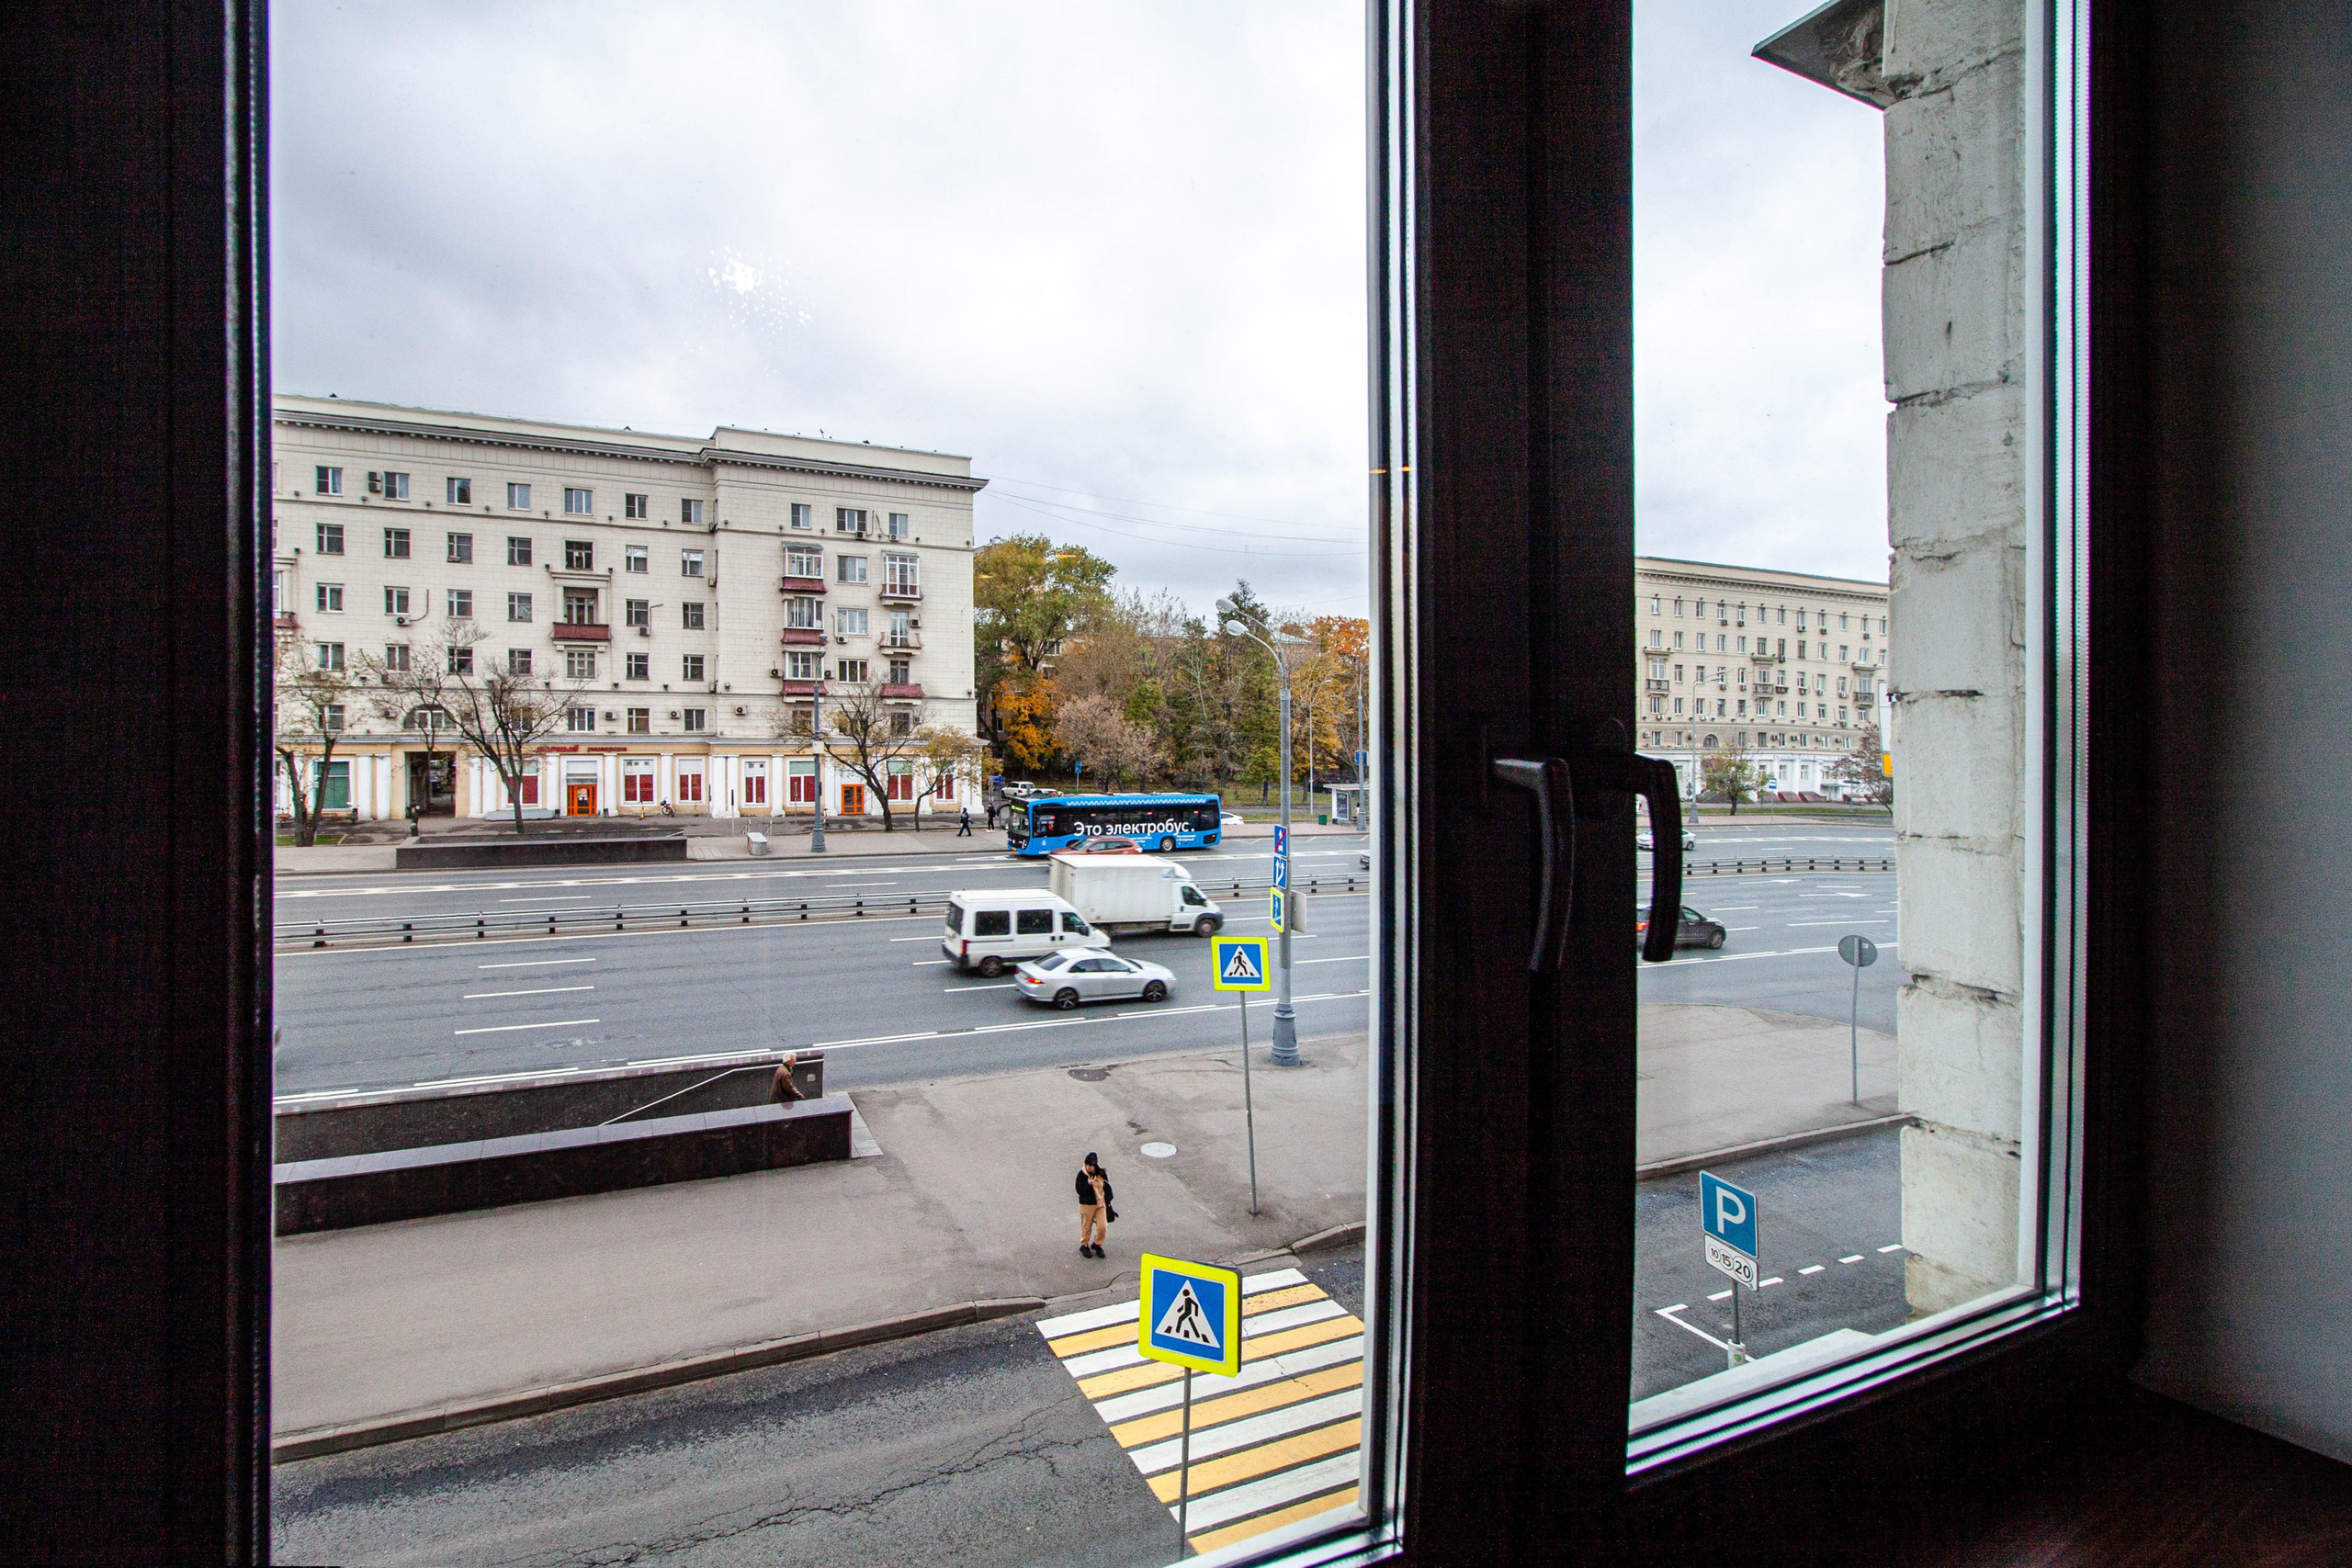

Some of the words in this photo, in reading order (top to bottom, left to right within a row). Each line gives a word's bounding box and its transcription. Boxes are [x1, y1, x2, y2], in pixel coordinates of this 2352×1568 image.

[1074, 822, 1102, 837] Это
[1106, 818, 1195, 836] электробус.
[1710, 1247, 1719, 1258] 10
[1721, 1253, 1732, 1268] 15
[1735, 1260, 1751, 1280] 20
